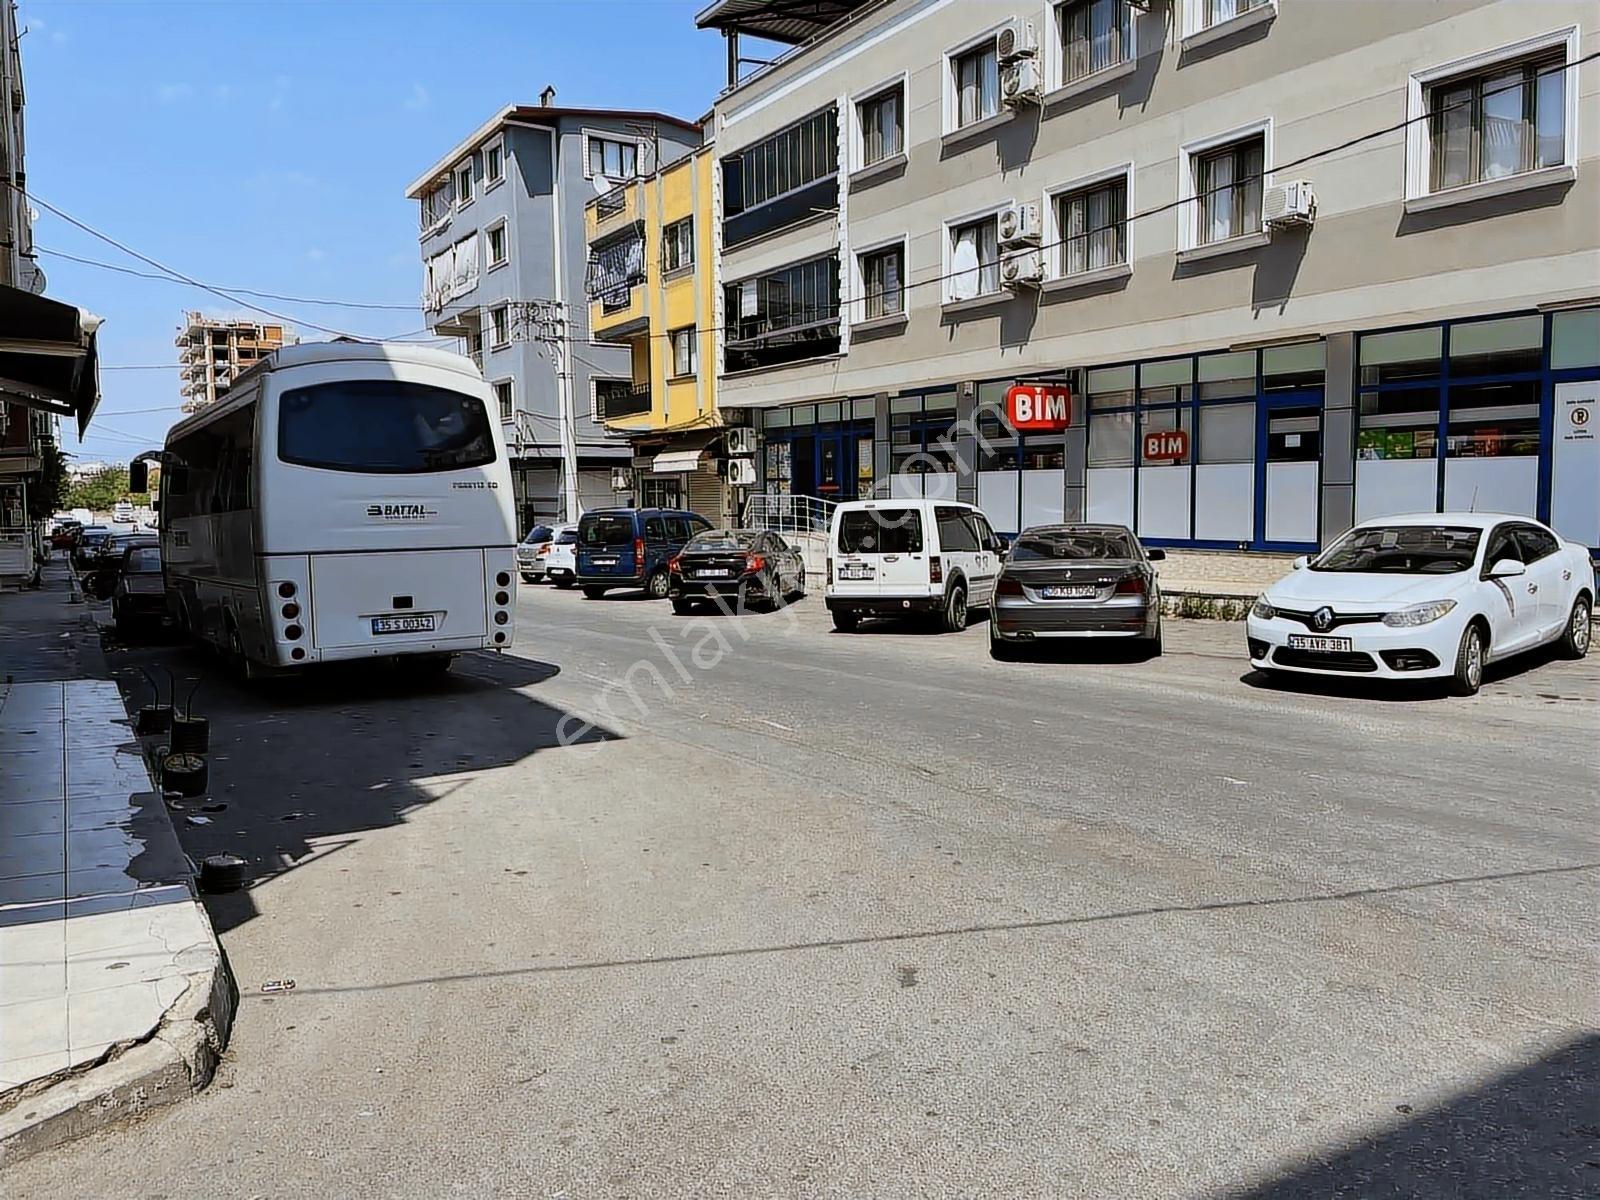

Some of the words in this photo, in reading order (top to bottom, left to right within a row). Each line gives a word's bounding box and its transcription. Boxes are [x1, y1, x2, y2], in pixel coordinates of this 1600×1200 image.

[1015, 387, 1067, 422] BİM
[1148, 432, 1183, 455] BİM
[384, 504, 426, 515] BATTAL
[380, 620, 392, 631] 35
[394, 620, 401, 630] S
[1295, 637, 1306, 649] 35
